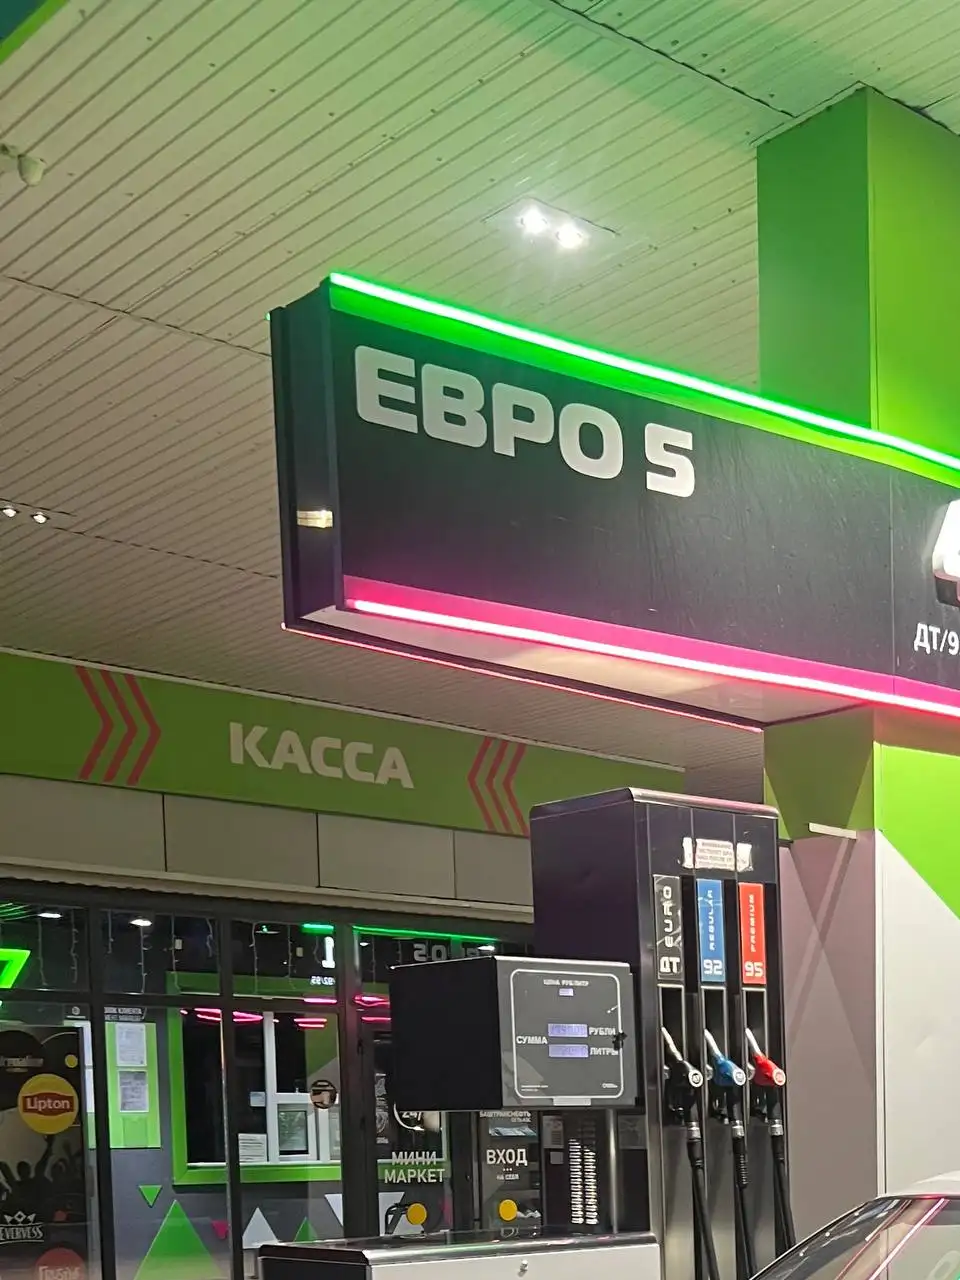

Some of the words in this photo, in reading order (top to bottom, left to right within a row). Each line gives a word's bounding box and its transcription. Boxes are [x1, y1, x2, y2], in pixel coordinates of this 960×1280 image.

[354, 344, 624, 481] ЕВРО
[644, 423, 696, 499] 5
[229, 721, 414, 790] КАССА
[707, 889, 716, 951] REGULAR
[748, 894, 757, 953] PREMIUM
[659, 956, 681, 974] ДТ
[703, 958, 724, 976] 92
[744, 960, 764, 978] 95
[516, 1035, 548, 1045] СУММА
[588, 1027, 616, 1036] РУБЛИ
[589, 1047, 619, 1056] ЛИТРЫ
[26, 1097, 71, 1112] Lipton
[391, 1151, 437, 1166] МИНИ
[486, 1148, 528, 1167] ВХОД
[384, 1168, 446, 1184] МАРКЕТ
